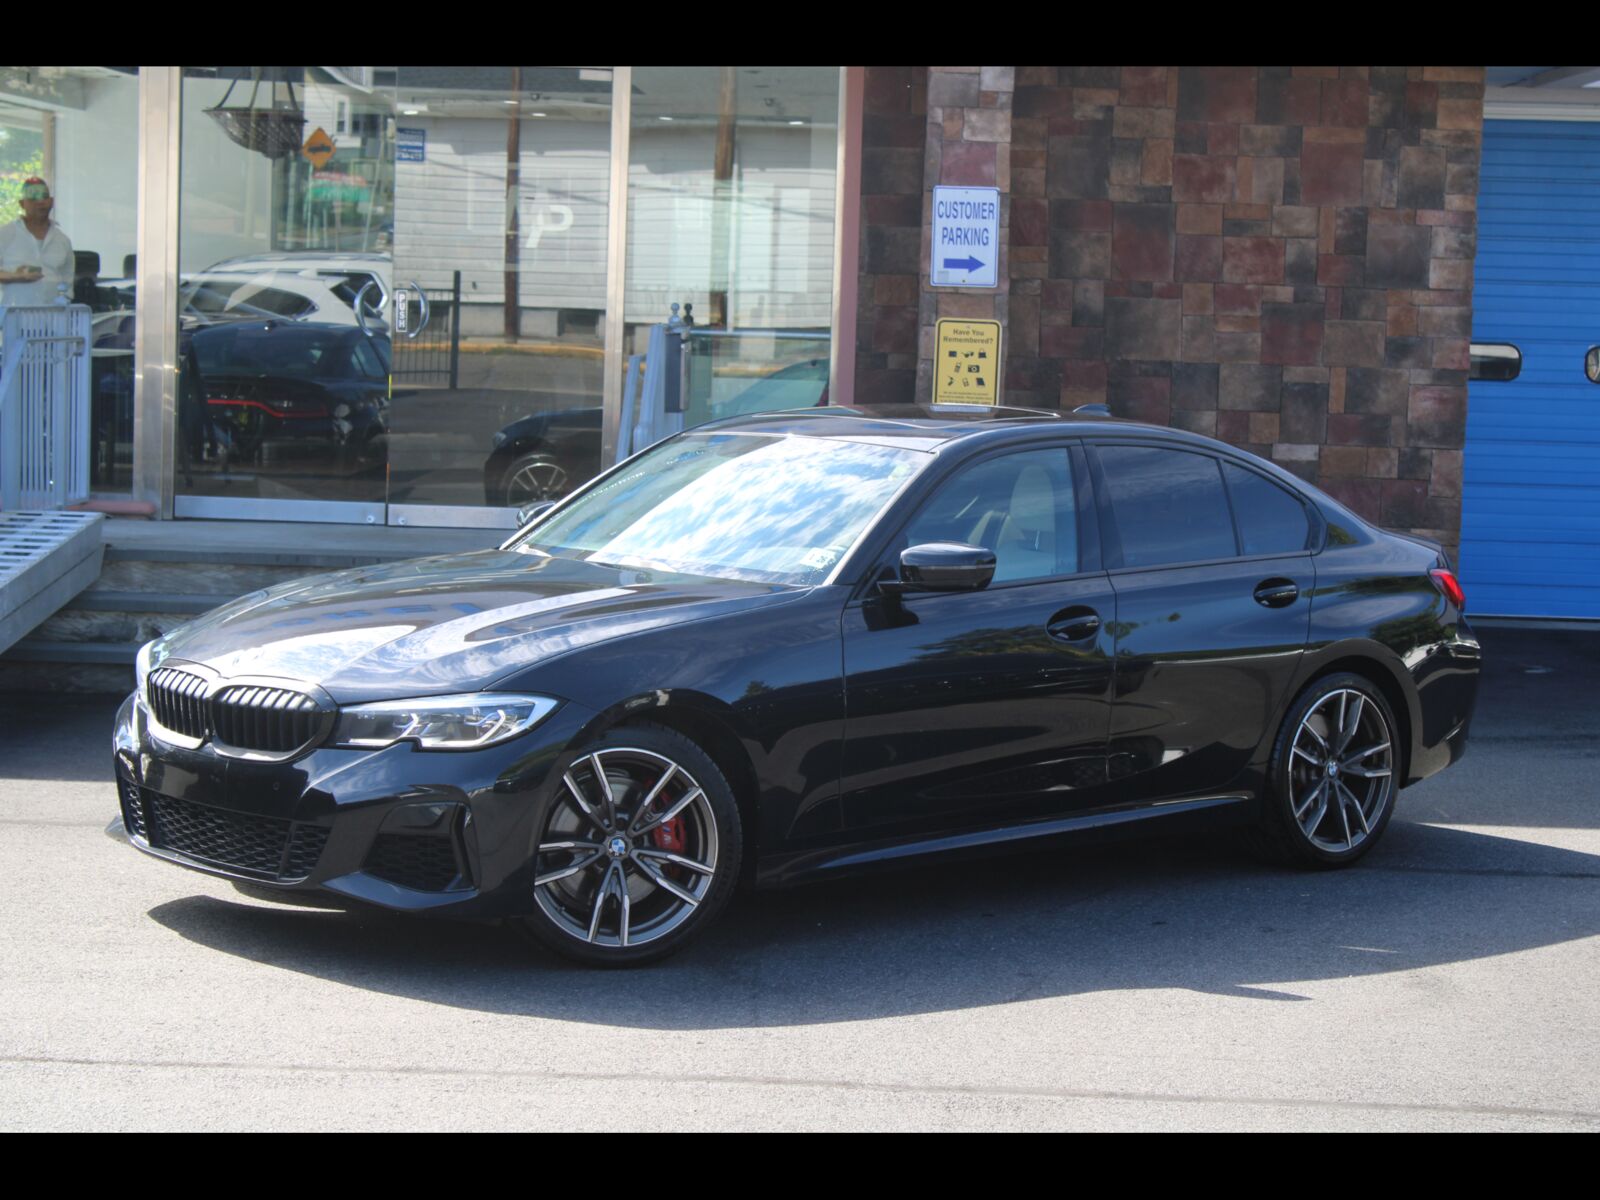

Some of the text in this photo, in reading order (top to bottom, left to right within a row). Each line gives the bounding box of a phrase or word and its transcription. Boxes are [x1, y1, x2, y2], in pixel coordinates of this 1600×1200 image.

[937, 201, 995, 220] CUSTOMER
[941, 226, 990, 246] PARKING
[398, 293, 406, 328] PUSH
[943, 336, 994, 345] Remembered?
[953, 328, 971, 336] Have
